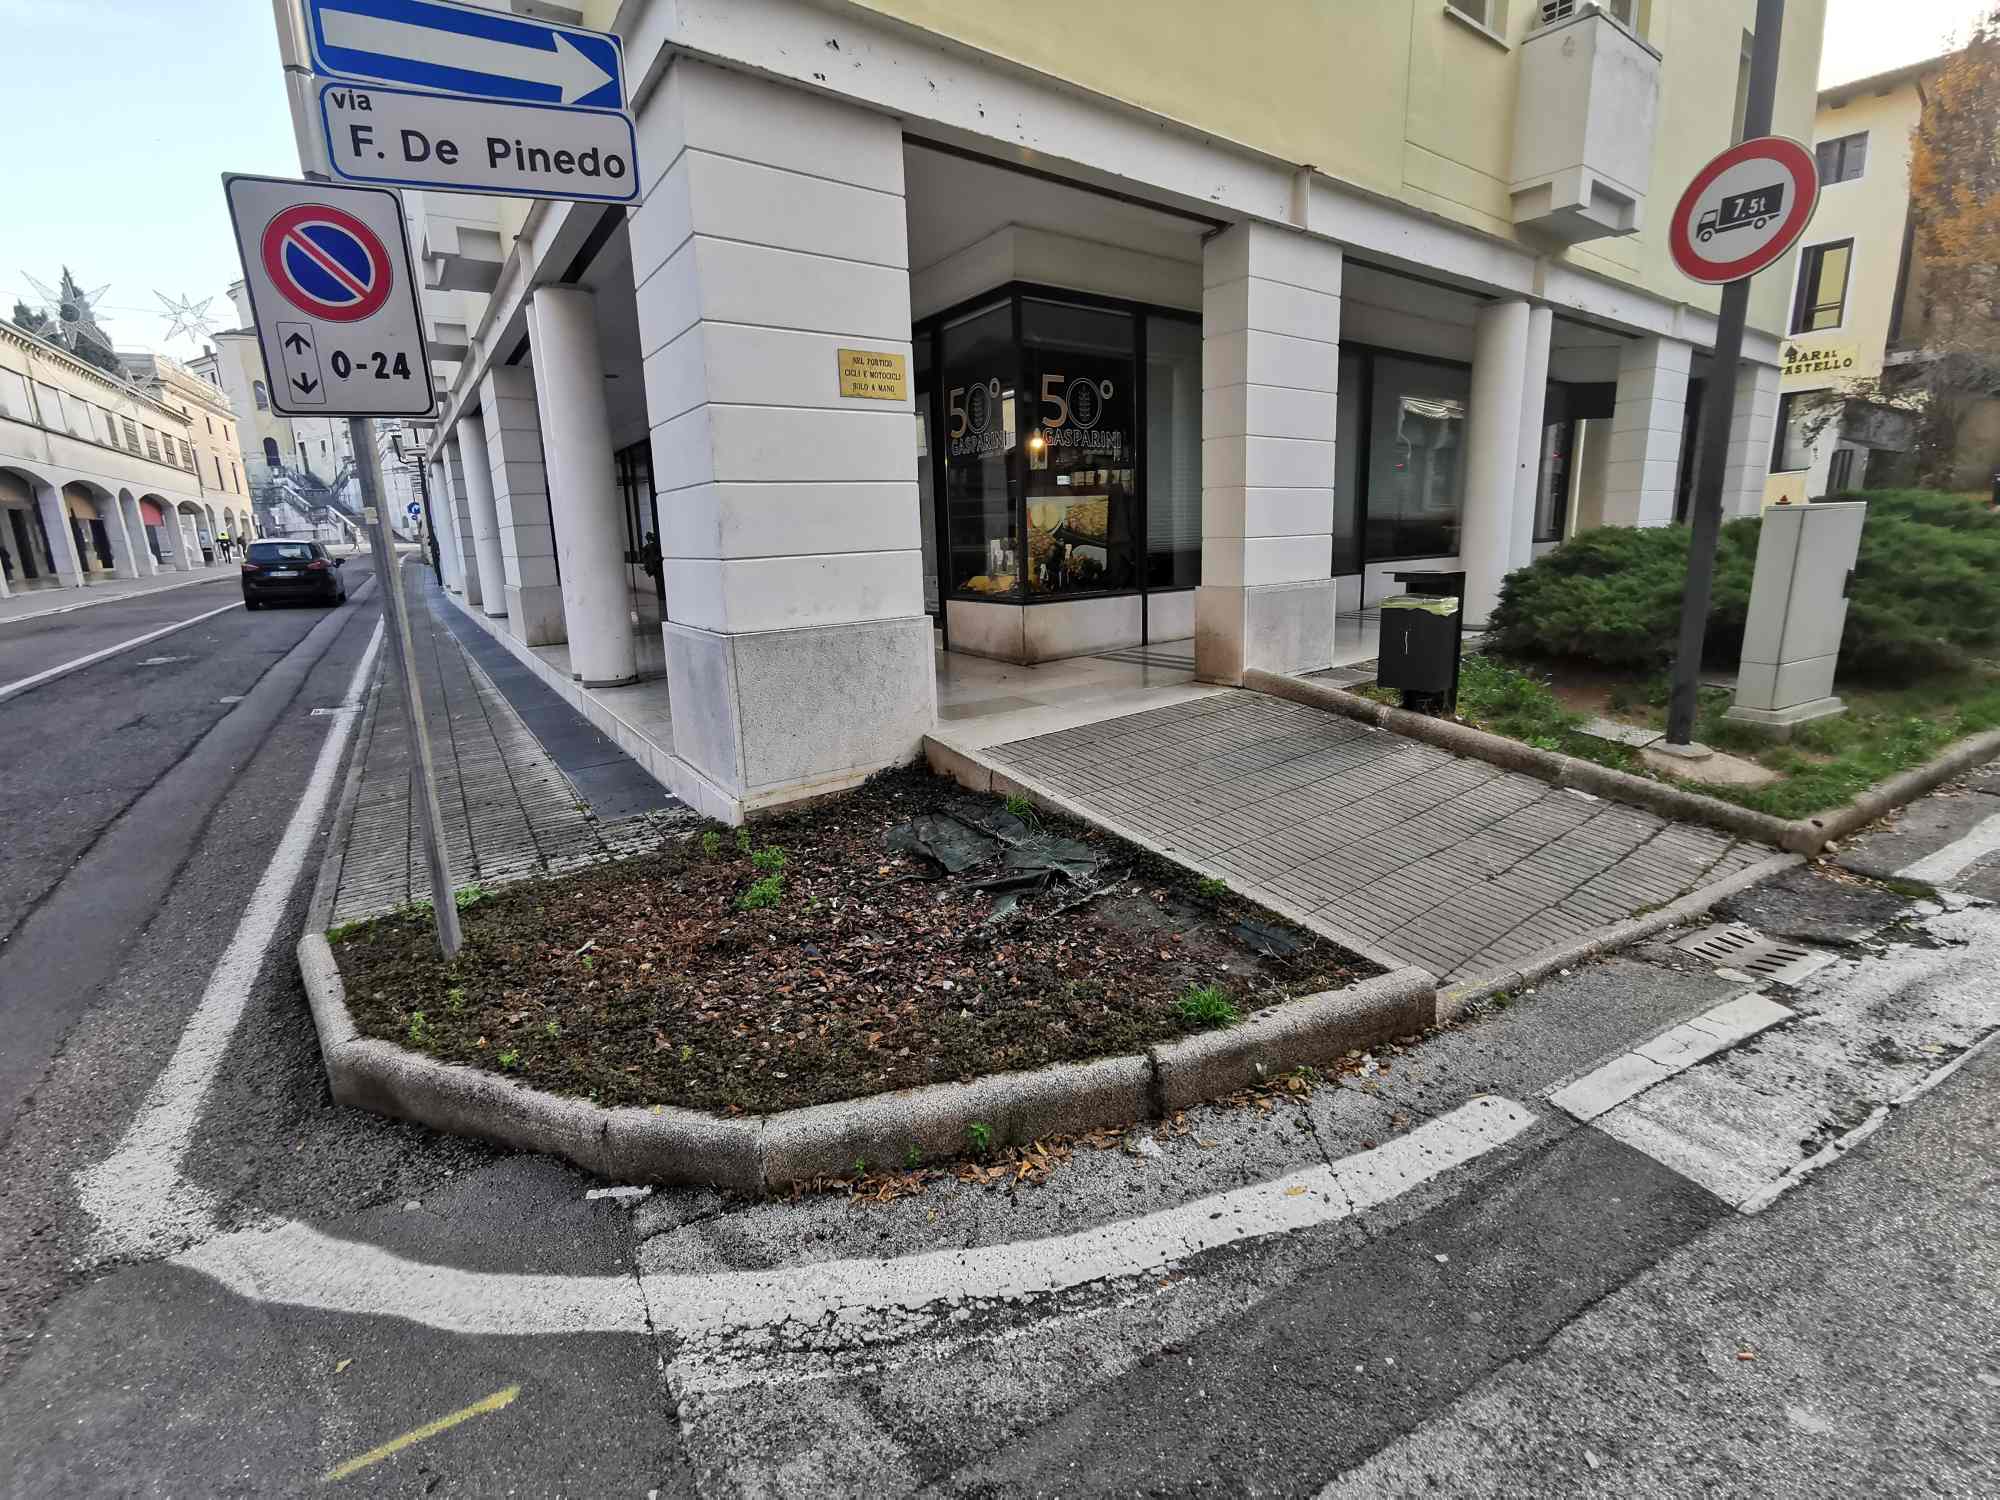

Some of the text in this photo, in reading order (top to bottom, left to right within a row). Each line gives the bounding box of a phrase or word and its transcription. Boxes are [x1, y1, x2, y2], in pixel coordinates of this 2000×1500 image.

[332, 89, 373, 111] via
[350, 124, 626, 179] F. De Pinedo
[331, 350, 412, 381] 0-24
[1784, 358, 1853, 376] ASTELLO
[1788, 351, 1821, 364] BAR
[845, 369, 861, 377] CICLI
[870, 371, 901, 380] MOTOCICLI
[852, 383, 869, 392] SOLO
[879, 385, 895, 393] MANO
[951, 431, 1008, 456] GASPARINI
[1043, 428, 1122, 449] GASPARINI
